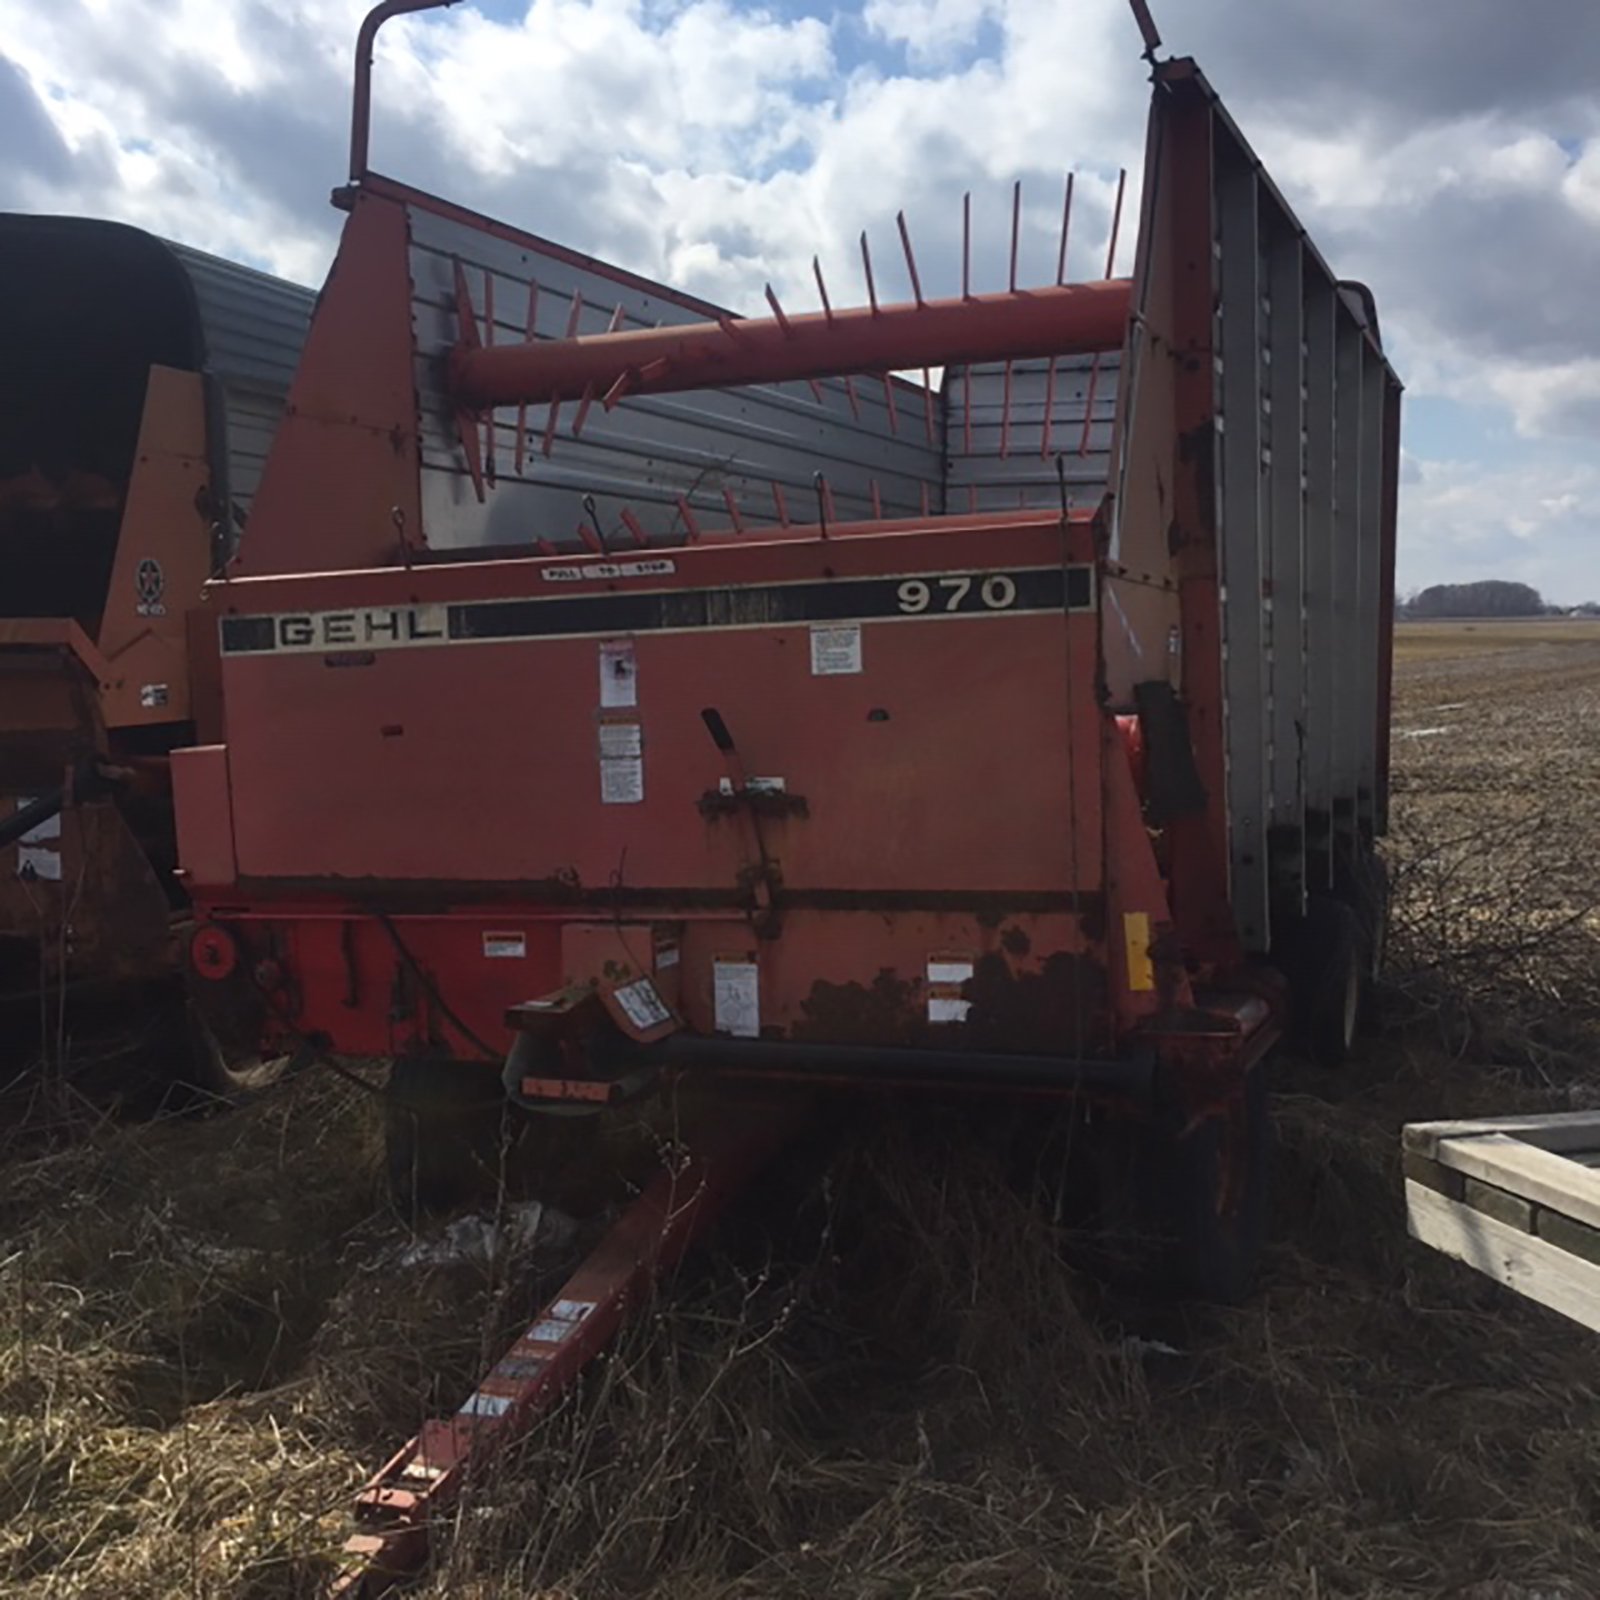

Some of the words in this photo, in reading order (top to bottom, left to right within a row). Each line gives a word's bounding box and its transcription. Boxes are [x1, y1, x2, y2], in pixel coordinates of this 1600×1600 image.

[549, 569, 577, 579] PULL
[598, 566, 616, 576] TO
[897, 575, 1016, 613] 970
[279, 610, 443, 646] GEHL
